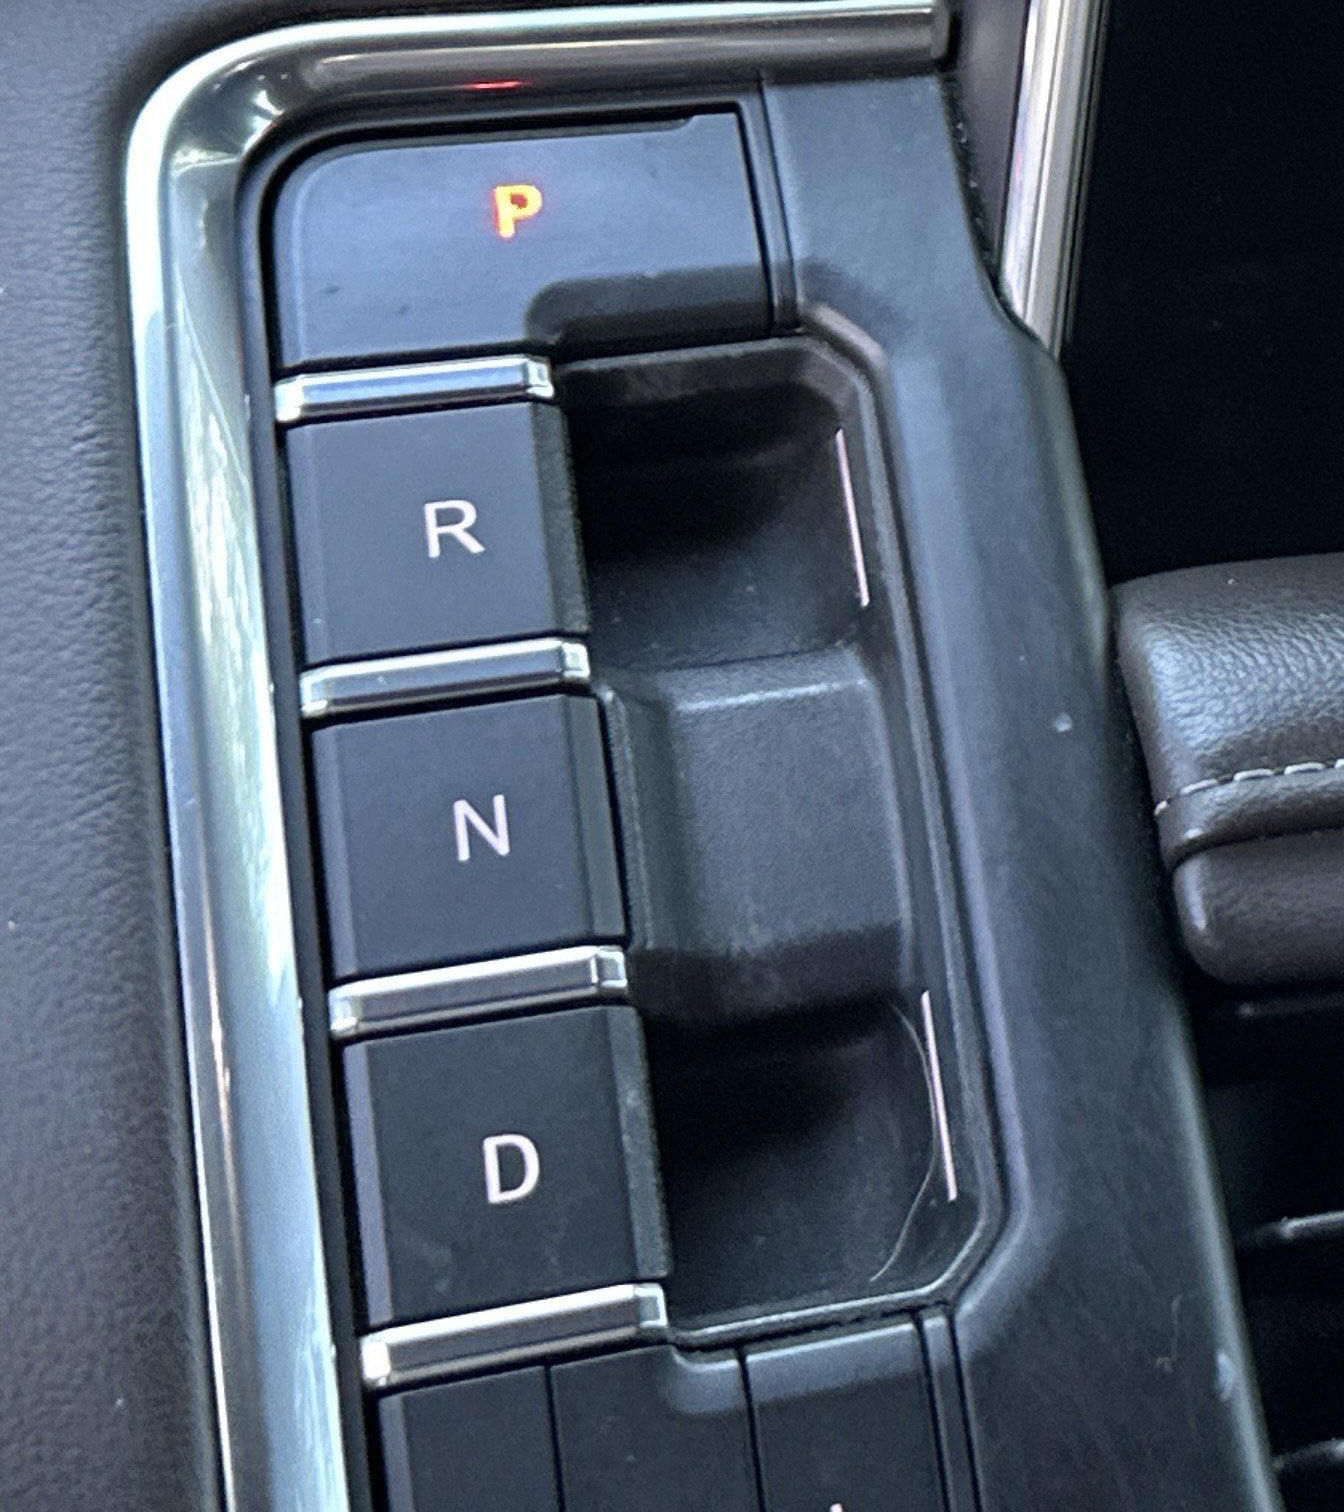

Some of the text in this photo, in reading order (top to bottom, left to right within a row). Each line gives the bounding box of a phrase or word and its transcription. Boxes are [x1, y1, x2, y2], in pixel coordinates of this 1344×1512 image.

[489, 183, 544, 241] P
[422, 498, 486, 560] R
[452, 793, 511, 863] N
[481, 1133, 541, 1205] D
